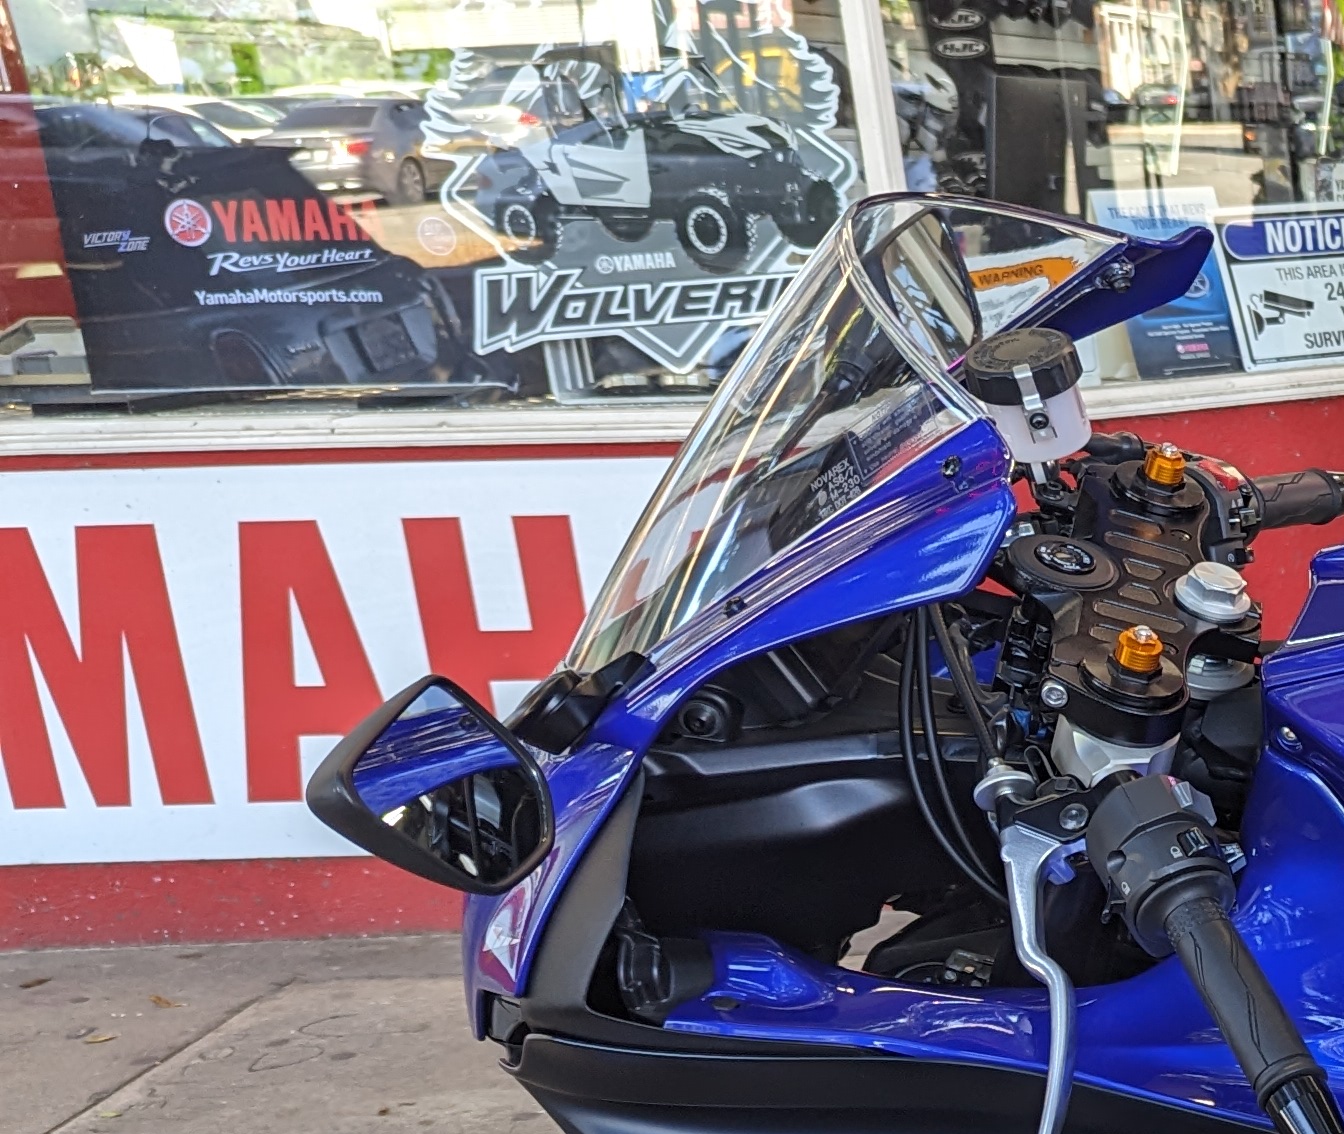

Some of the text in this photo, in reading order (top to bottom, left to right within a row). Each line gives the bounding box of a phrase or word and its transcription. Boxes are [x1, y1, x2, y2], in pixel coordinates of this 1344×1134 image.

[211, 198, 387, 243] YAMAHA
[84, 230, 130, 247] VICTORY
[118, 239, 149, 253] ZONE
[207, 249, 375, 276] Revs Your Heart
[613, 252, 676, 272] YAMAHA
[1276, 267, 1303, 282] THIS
[1306, 264, 1338, 280] AREA
[977, 264, 1044, 286] WARNING
[194, 288, 383, 306] YamahaMotorsports.com
[484, 273, 797, 342] WOLVERI
[810, 457, 851, 492] NOVAREX
[829, 475, 861, 501] M-230
[0, 515, 600, 810] MAH
